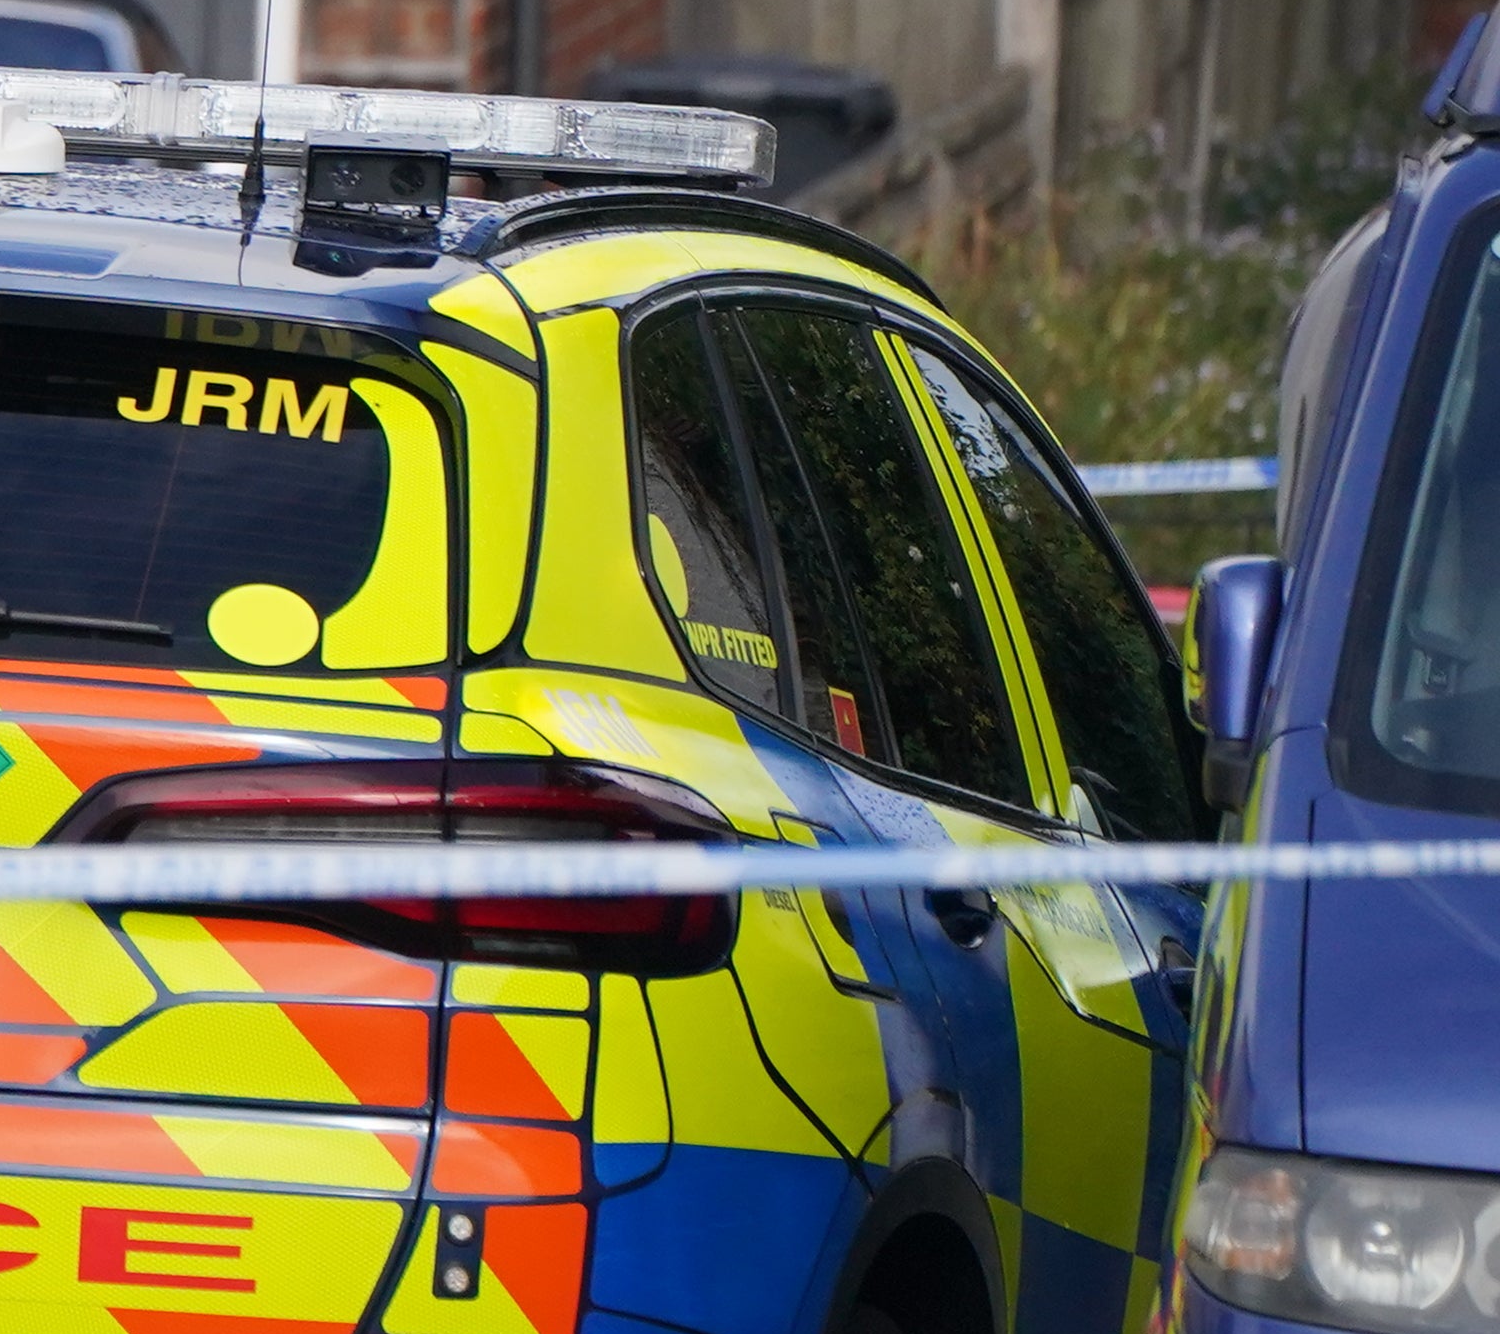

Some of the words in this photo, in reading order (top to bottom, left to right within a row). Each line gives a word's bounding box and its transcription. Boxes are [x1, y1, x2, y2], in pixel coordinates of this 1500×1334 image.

[116, 367, 350, 444] JRM
[720, 626, 778, 669] FITTED
[543, 688, 661, 759] JRM
[762, 887, 798, 914] DIESEL
